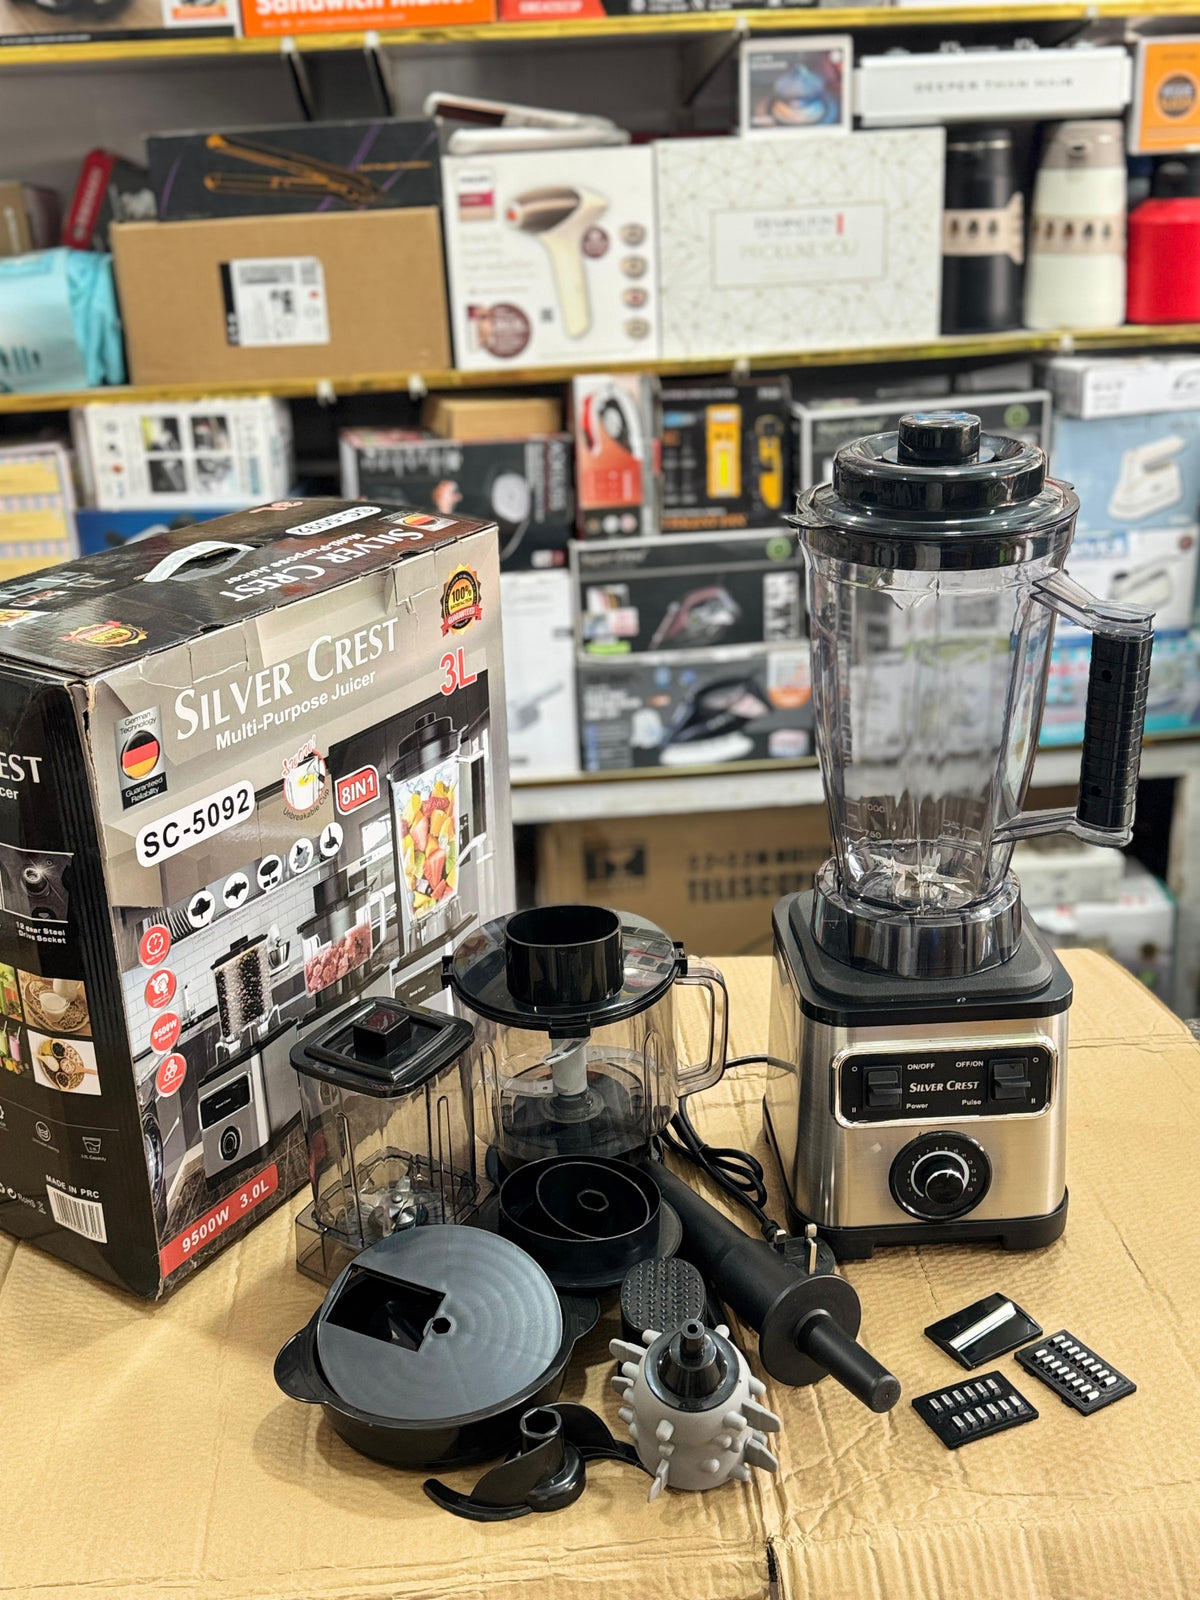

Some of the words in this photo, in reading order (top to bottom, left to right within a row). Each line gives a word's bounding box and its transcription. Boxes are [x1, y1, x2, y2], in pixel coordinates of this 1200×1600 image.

[270, 533, 366, 568] Multi-Purpose
[316, 528, 424, 564] SILVER
[219, 564, 325, 601] CREST
[225, 566, 272, 584] Juicer
[452, 585, 472, 603] 100%
[448, 607, 475, 624] GUARANTEED
[173, 662, 293, 741] SILVER
[306, 617, 399, 682] CREST
[440, 646, 477, 696] 3L
[124, 712, 151, 726] German
[215, 692, 329, 750] Multi-Purpose
[331, 670, 376, 701] Juicer
[119, 717, 157, 735] Technology
[125, 776, 163, 798] Guaranteed
[131, 786, 160, 804] Reliability
[341, 774, 374, 805] 8IN1
[283, 804, 320, 820] Unbreakable
[143, 788, 250, 858] SC-5092
[864, 830, 881, 839] 750
[36, 935, 67, 944] Socket
[43, 928, 66, 936] Steel
[153, 1018, 178, 1040] 9500W
[907, 1062, 936, 1071] ON/OFF
[955, 1060, 984, 1069] OFF/ON
[909, 1081, 943, 1093] SILVER
[946, 1080, 980, 1091] CREST
[906, 1102, 929, 1110] Power
[961, 1099, 982, 1107] Pulse
[45, 1174, 67, 1190] MADE
[68, 1185, 77, 1195] IN
[80, 1188, 100, 1200] PRC
[182, 1206, 230, 1253] 9500W
[239, 1180, 270, 1208] 3.0L
